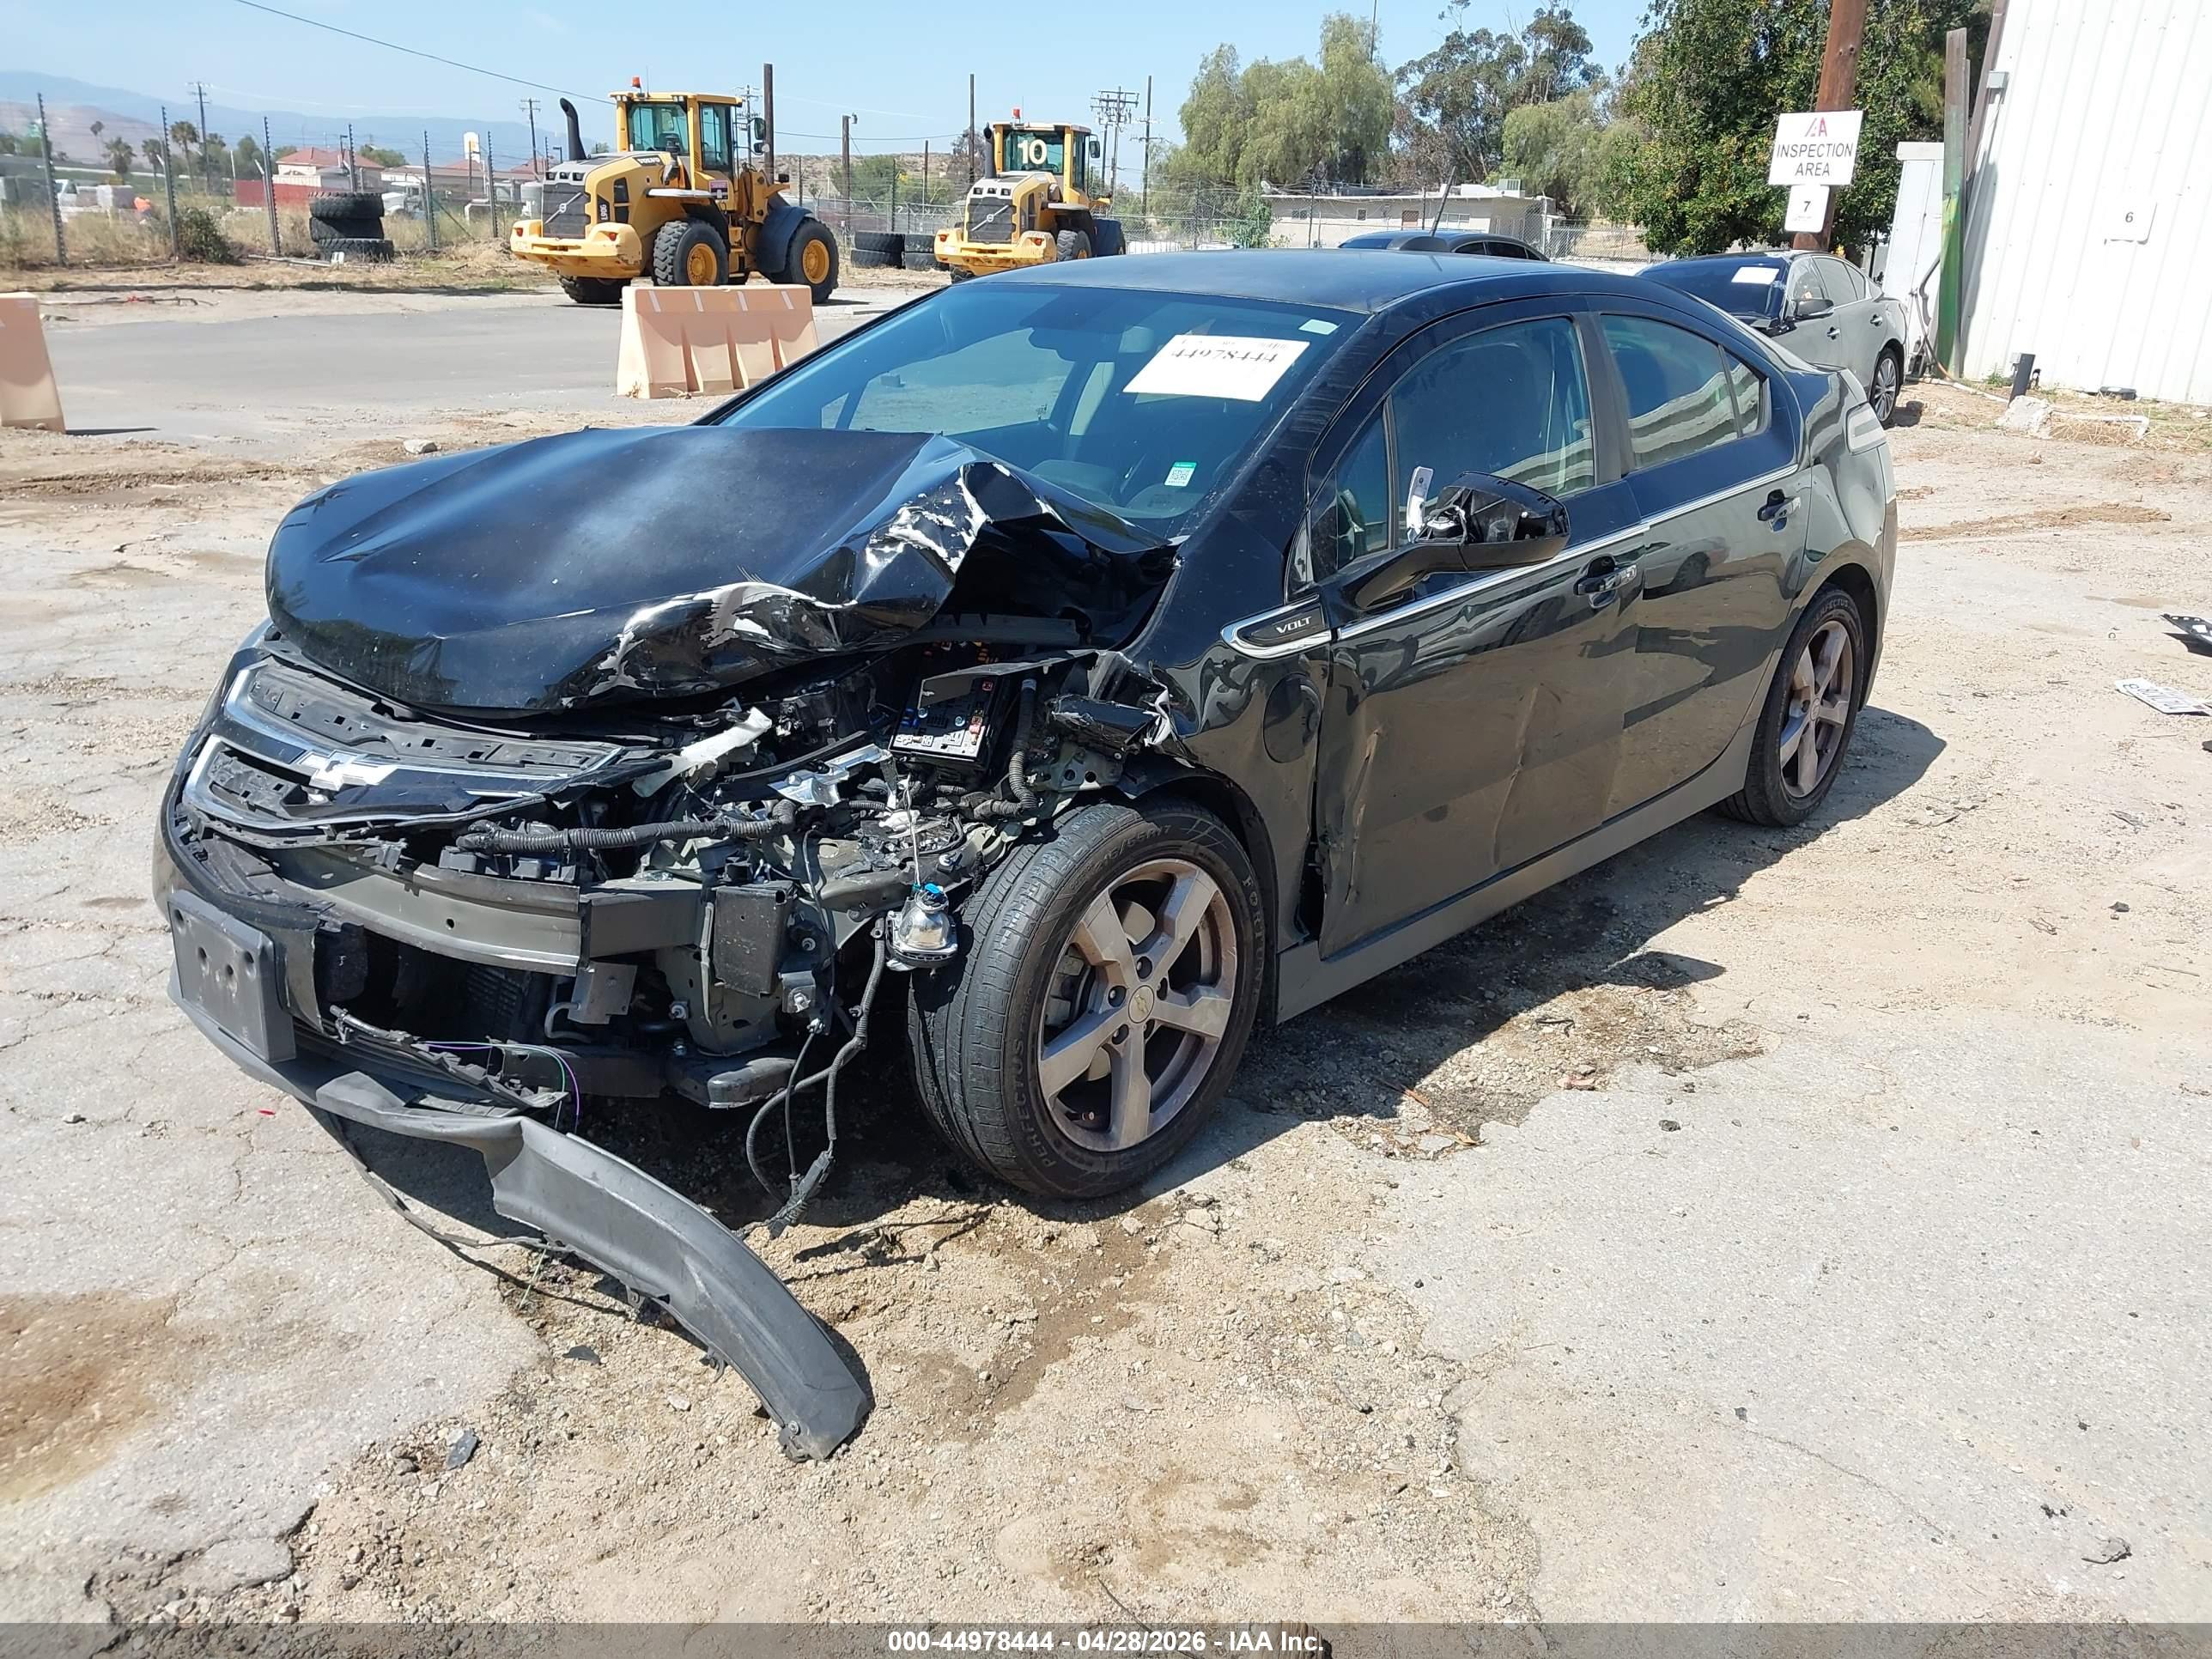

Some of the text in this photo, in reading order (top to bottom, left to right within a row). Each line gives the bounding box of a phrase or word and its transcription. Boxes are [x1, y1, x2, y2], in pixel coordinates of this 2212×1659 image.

[1018, 139, 1047, 164] 10
[1777, 143, 1854, 158] INSPECTION
[1795, 162, 1830, 176] AREA
[1804, 201, 1811, 213] 7
[2125, 211, 2134, 223] 6
[1276, 616, 1312, 634] VOLT
[1013, 1038, 1057, 1168] PERFECTUS
